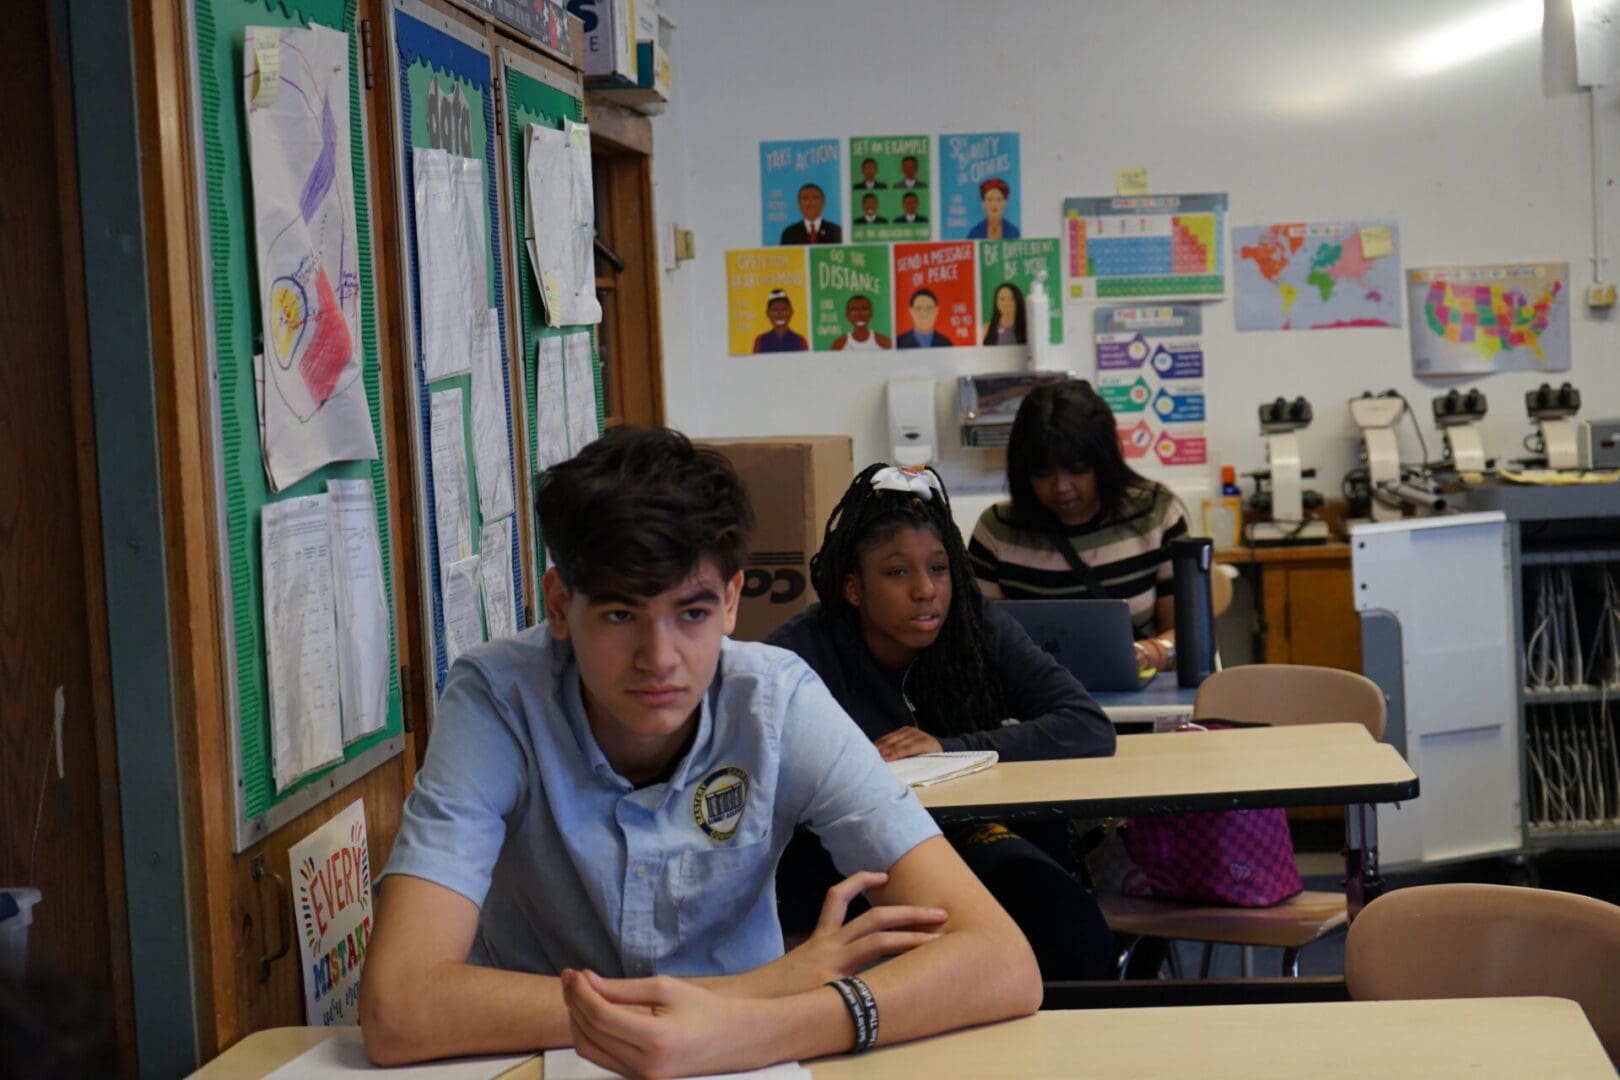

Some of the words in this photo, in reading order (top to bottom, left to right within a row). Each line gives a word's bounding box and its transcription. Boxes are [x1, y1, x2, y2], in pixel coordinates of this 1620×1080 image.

[427, 74, 473, 158] data
[795, 143, 839, 172] ACTION
[897, 253, 922, 272] SEND
[931, 244, 973, 265] MESSAGE
[983, 243, 999, 268] BE
[818, 261, 881, 295] DISTANCE
[927, 263, 959, 285] PEACE
[1003, 259, 1018, 281] BE
[309, 846, 363, 938] EVERY
